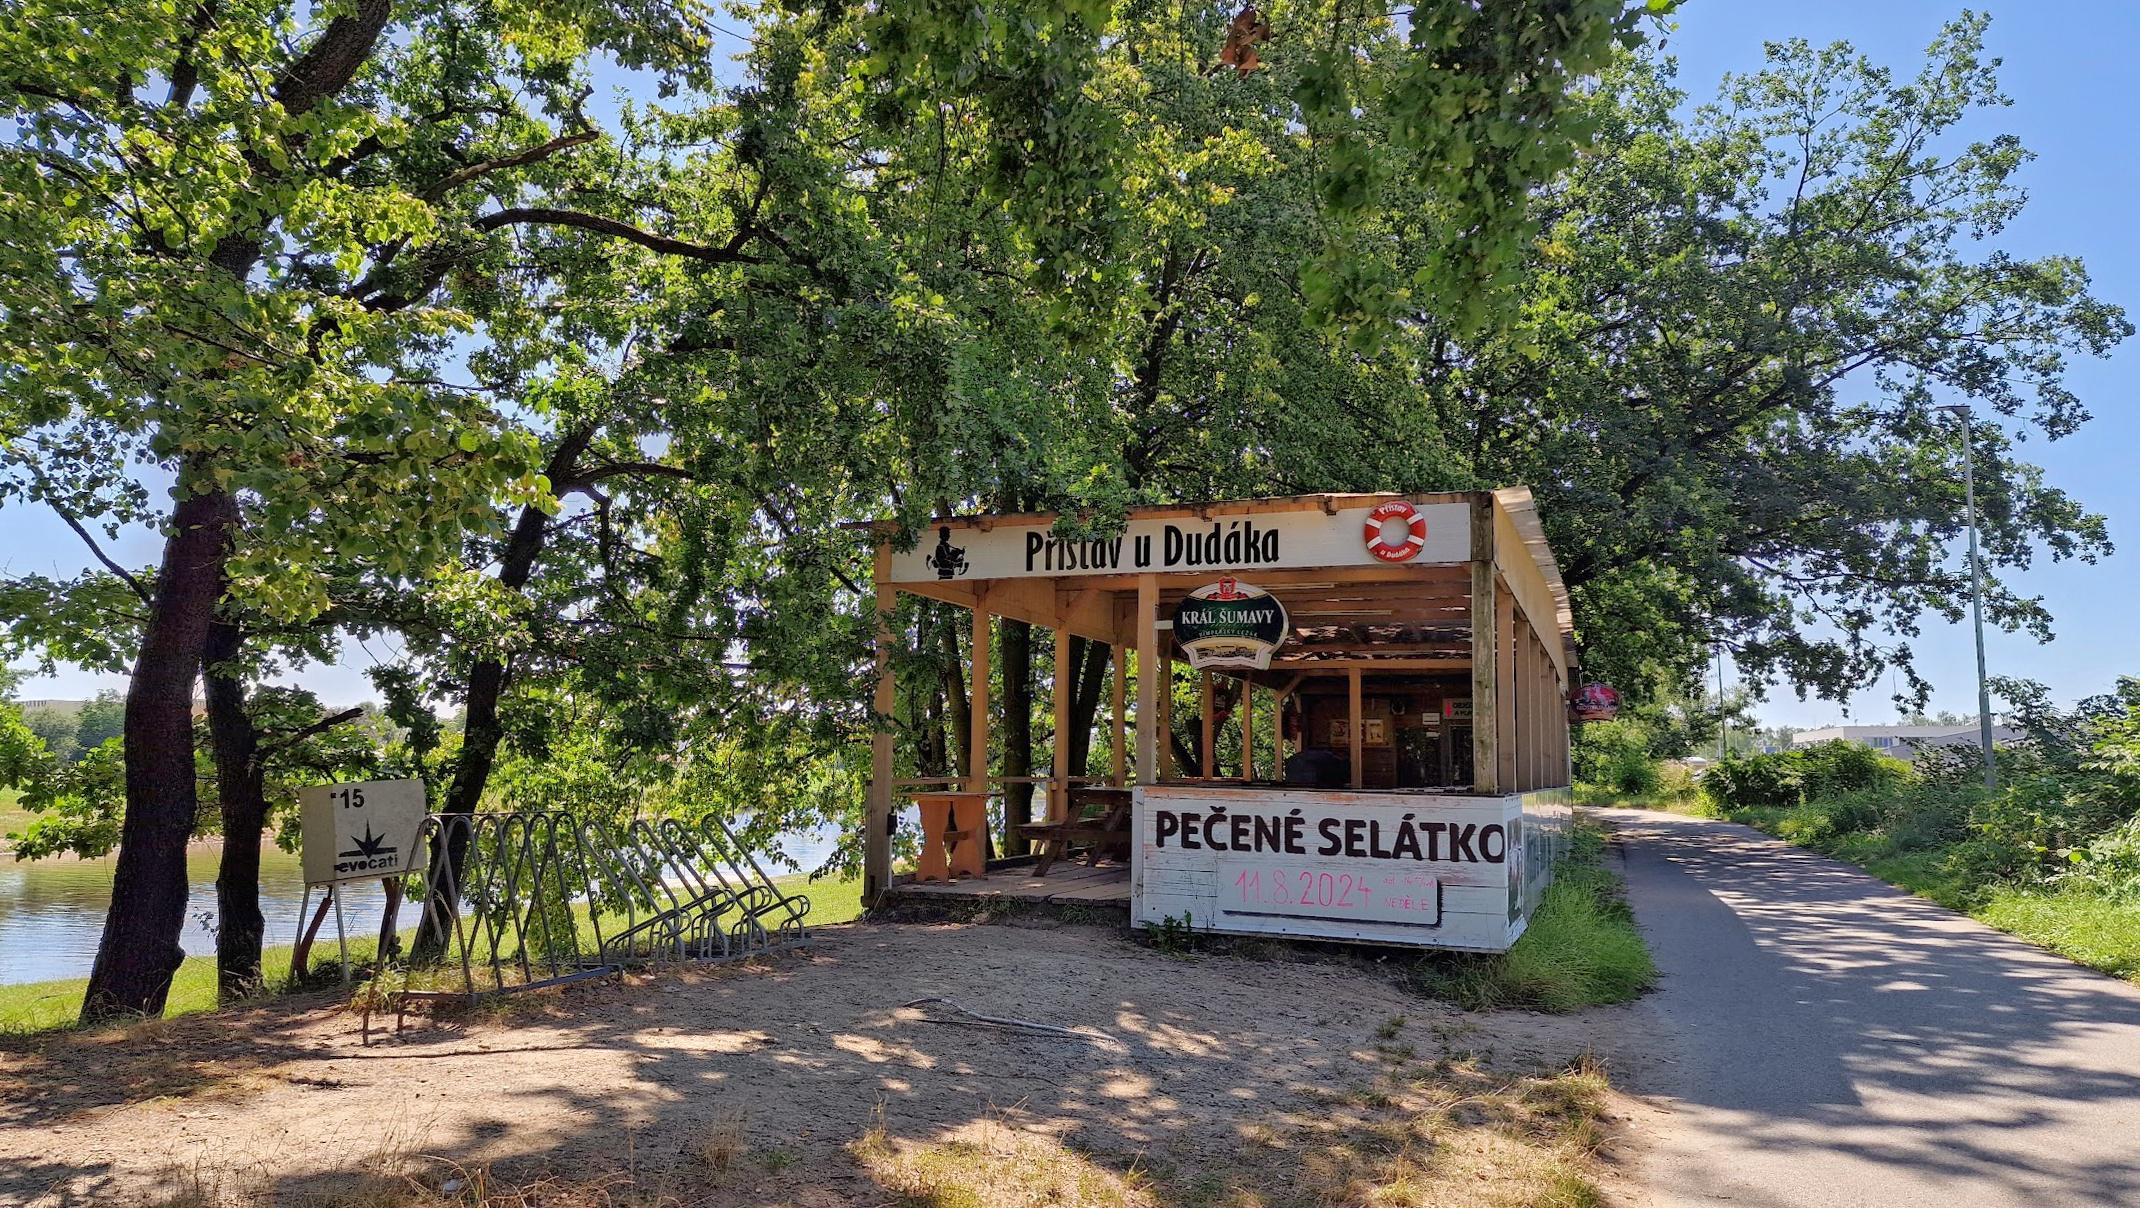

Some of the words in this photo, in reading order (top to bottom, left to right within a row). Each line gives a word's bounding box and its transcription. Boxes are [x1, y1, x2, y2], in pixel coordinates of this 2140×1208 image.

[1134, 535, 1151, 568] u
[1163, 521, 1280, 567] Dudáka
[1181, 608, 1216, 625] KRÁL
[1219, 608, 1275, 625] ŠUMAVY
[339, 788, 365, 809] 15
[1156, 805, 1306, 855] PEČENÉ
[1317, 813, 1505, 863] SELÁTKO
[335, 854, 398, 873] evocati
